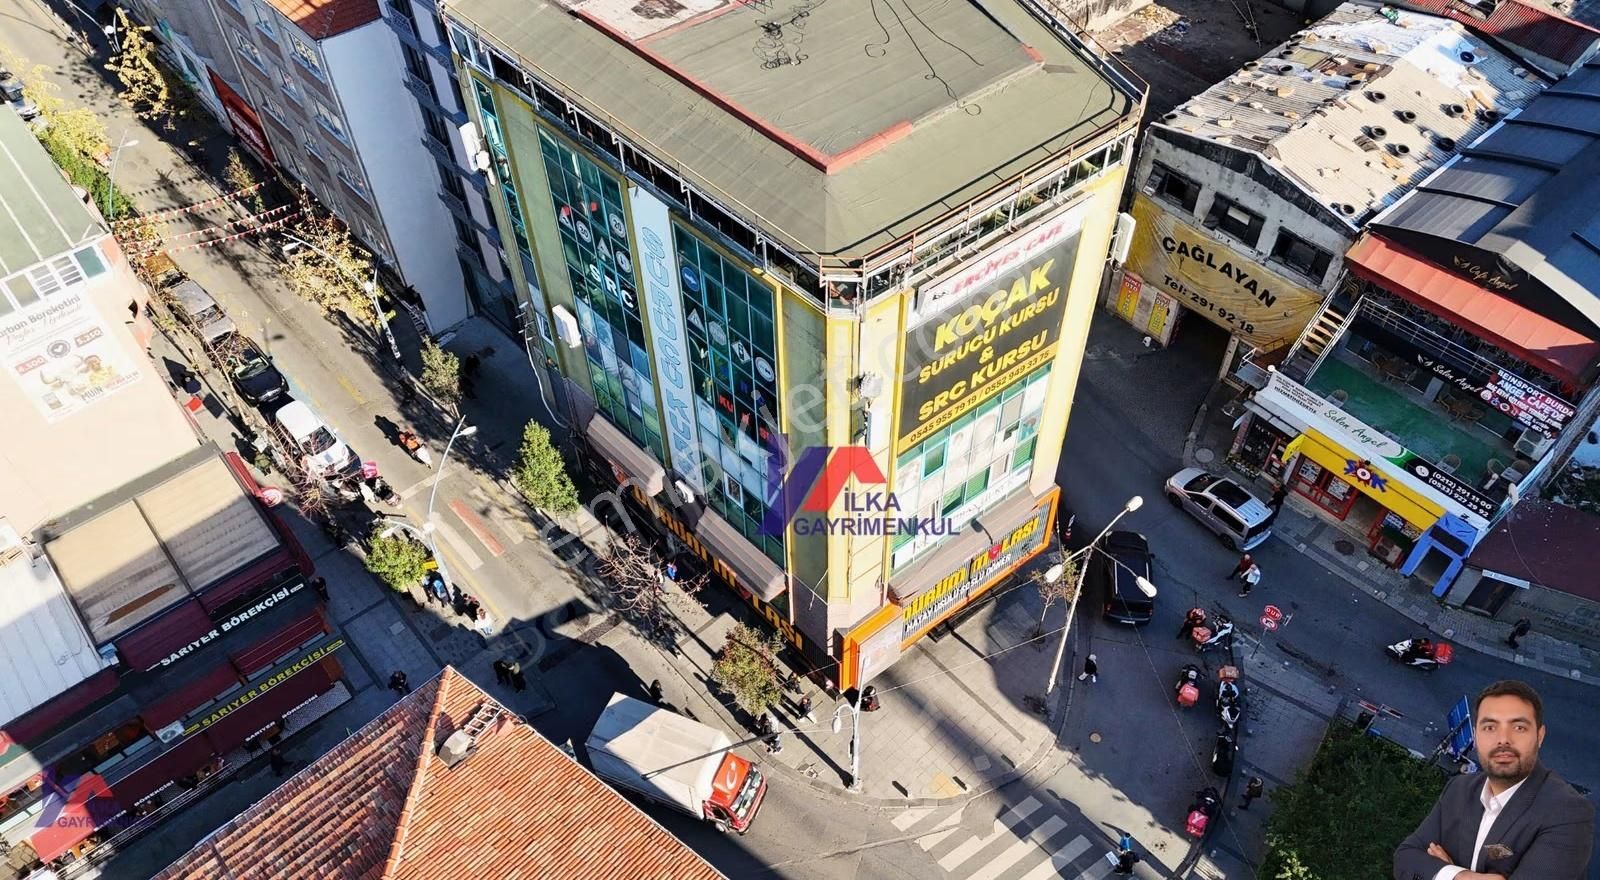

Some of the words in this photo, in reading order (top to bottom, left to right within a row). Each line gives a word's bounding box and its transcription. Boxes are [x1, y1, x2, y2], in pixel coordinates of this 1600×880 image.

[589, 263, 634, 309] SRC
[1162, 236, 1277, 308] ÇAĞLAYAN
[934, 259, 1055, 352] KOÇAK
[999, 287, 1060, 337] KURSU
[1164, 274, 1187, 295] Tel:
[1190, 293, 1214, 312] 291
[1217, 307, 1235, 325] 92
[1239, 320, 1255, 334] 18
[919, 381, 967, 421] SRC
[970, 329, 1048, 389] KURSU
[979, 346, 994, 364] &
[910, 421, 934, 443] 0545
[936, 410, 954, 427] 955
[954, 402, 966, 417] 79
[984, 375, 1008, 396] 0552
[1037, 351, 1049, 365] 75
[1432, 364, 1454, 380] Salon
[1454, 377, 1483, 393] Angel
[1497, 379, 1526, 400] ANGEL
[1497, 369, 1546, 400] BEINSPORT
[1545, 396, 1574, 417] BURDA
[1323, 409, 1350, 430] Salon
[1352, 427, 1388, 448] Angel
[1428, 477, 1453, 495] (0533)
[1453, 491, 1467, 503] 927
[1467, 499, 1478, 509] 29
[1477, 507, 1489, 517] 92
[1432, 471, 1457, 490] (0212)
[1457, 485, 1471, 498] 291
[1470, 493, 1480, 504] 11
[1479, 499, 1493, 510] 00
[160, 629, 220, 667] SARIYER
[221, 587, 290, 632] BÖREKÇİSİ
[202, 689, 258, 727] SARIYER
[245, 721, 276, 742] SARIYER
